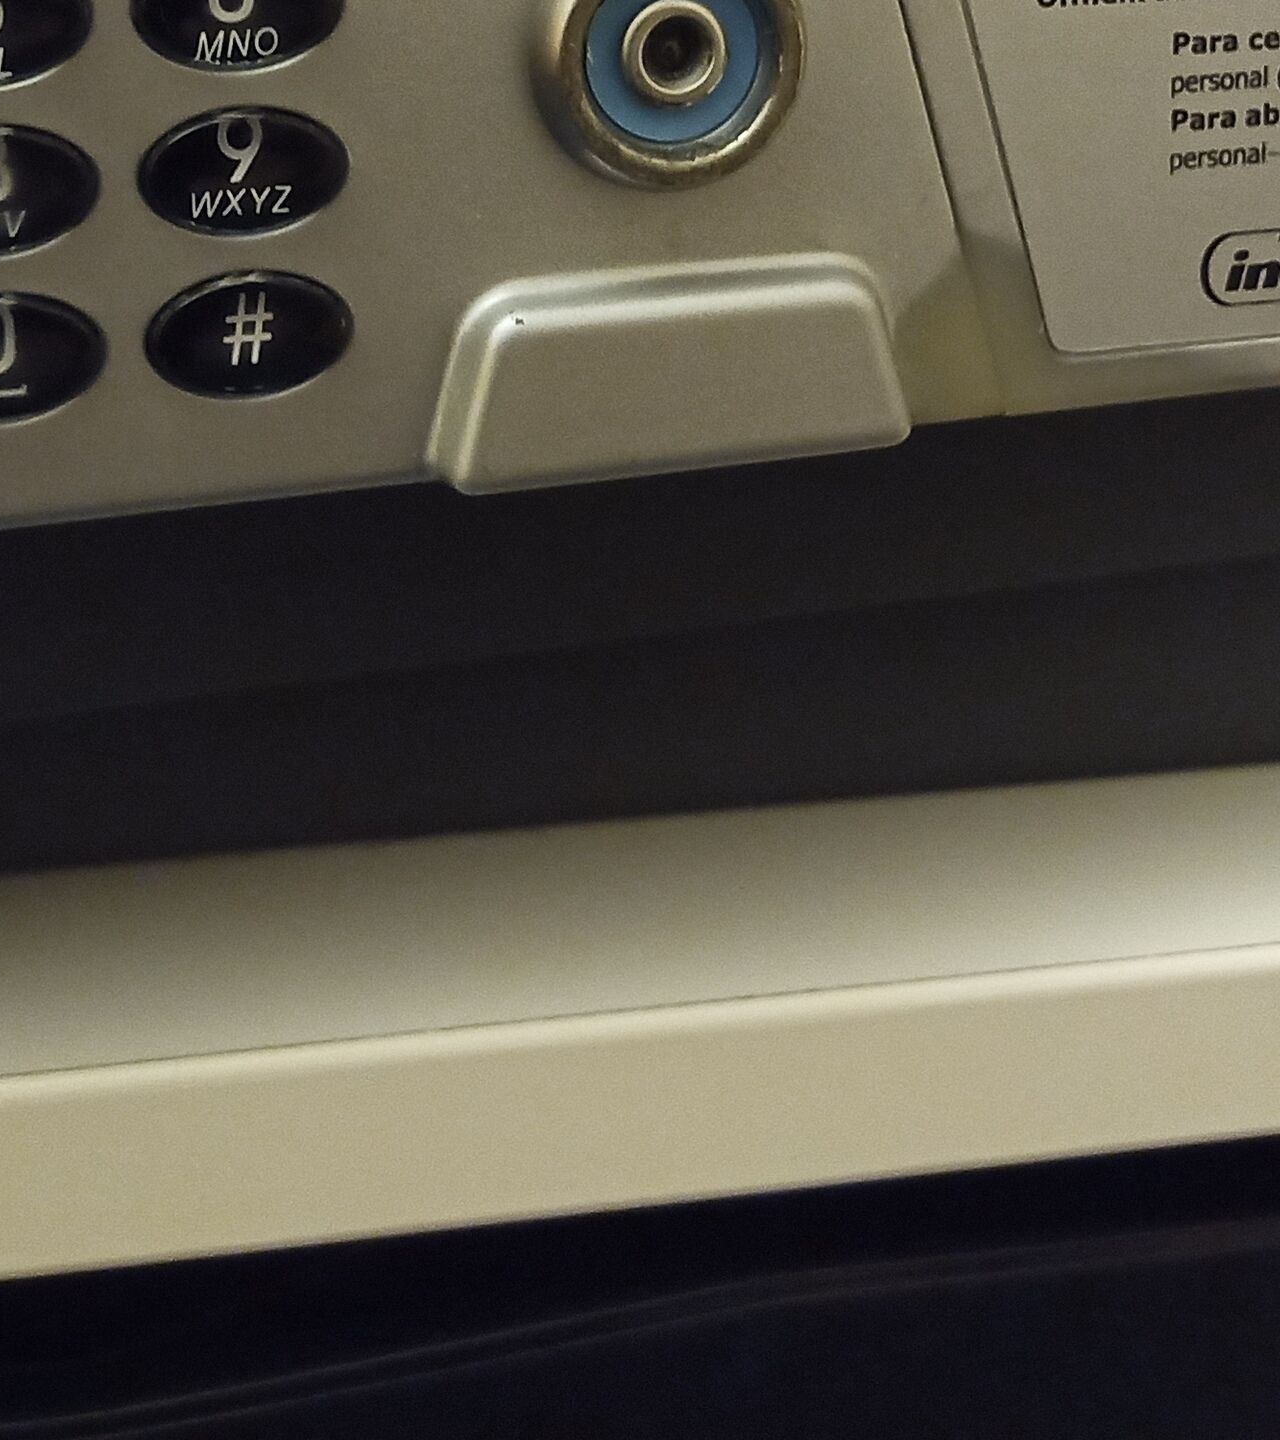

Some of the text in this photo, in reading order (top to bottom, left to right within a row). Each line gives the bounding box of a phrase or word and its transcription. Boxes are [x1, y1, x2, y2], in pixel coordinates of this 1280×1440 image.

[195, 29, 279, 63] MNO
[1172, 31, 1239, 56] Para
[1170, 65, 1269, 99] personal
[1170, 108, 1237, 132] Para
[217, 116, 263, 183] 9
[1169, 141, 1267, 176] personal
[191, 185, 291, 219] WXYZ
